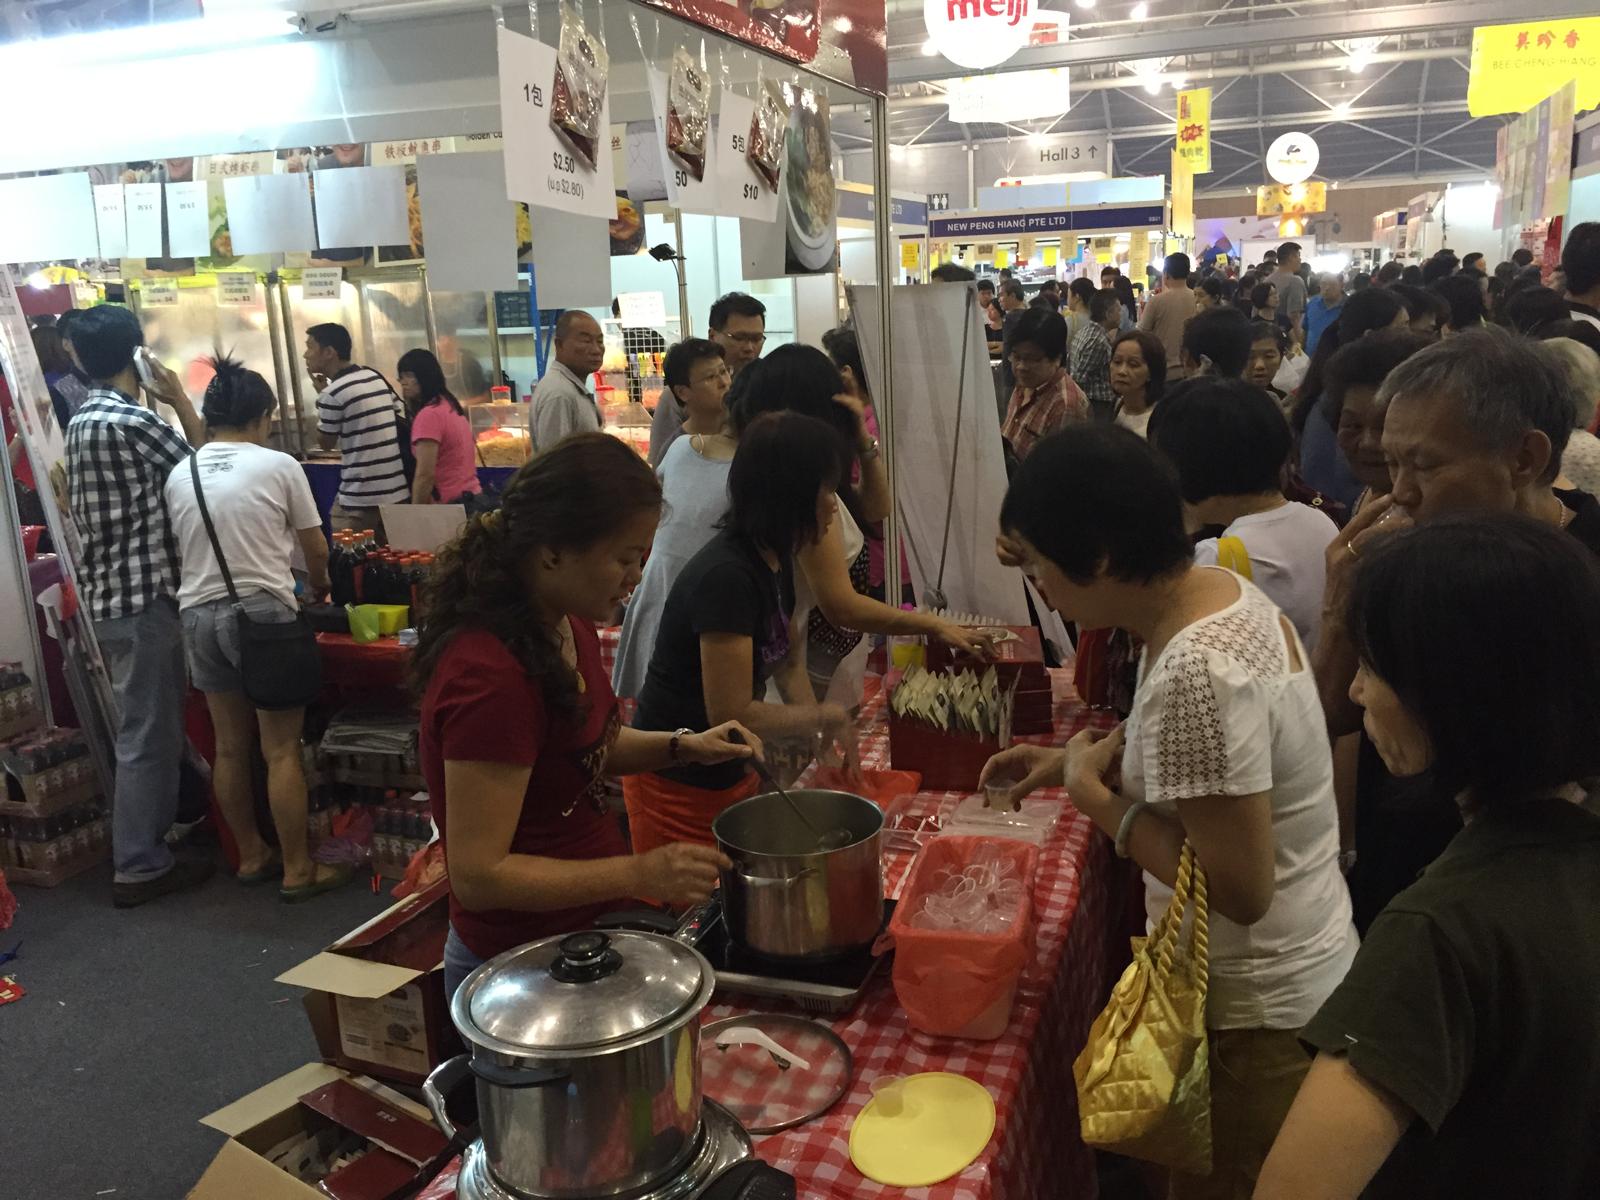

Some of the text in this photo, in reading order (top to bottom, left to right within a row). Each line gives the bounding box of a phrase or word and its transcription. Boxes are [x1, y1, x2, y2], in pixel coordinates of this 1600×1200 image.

[947, 0, 1028, 26] meiji
[553, 151, 575, 174] $2.50
[1040, 147, 1080, 162] Hall 3
[743, 183, 759, 200] $10
[947, 216, 1066, 232] NEW PENG HIANG PTE LTD
